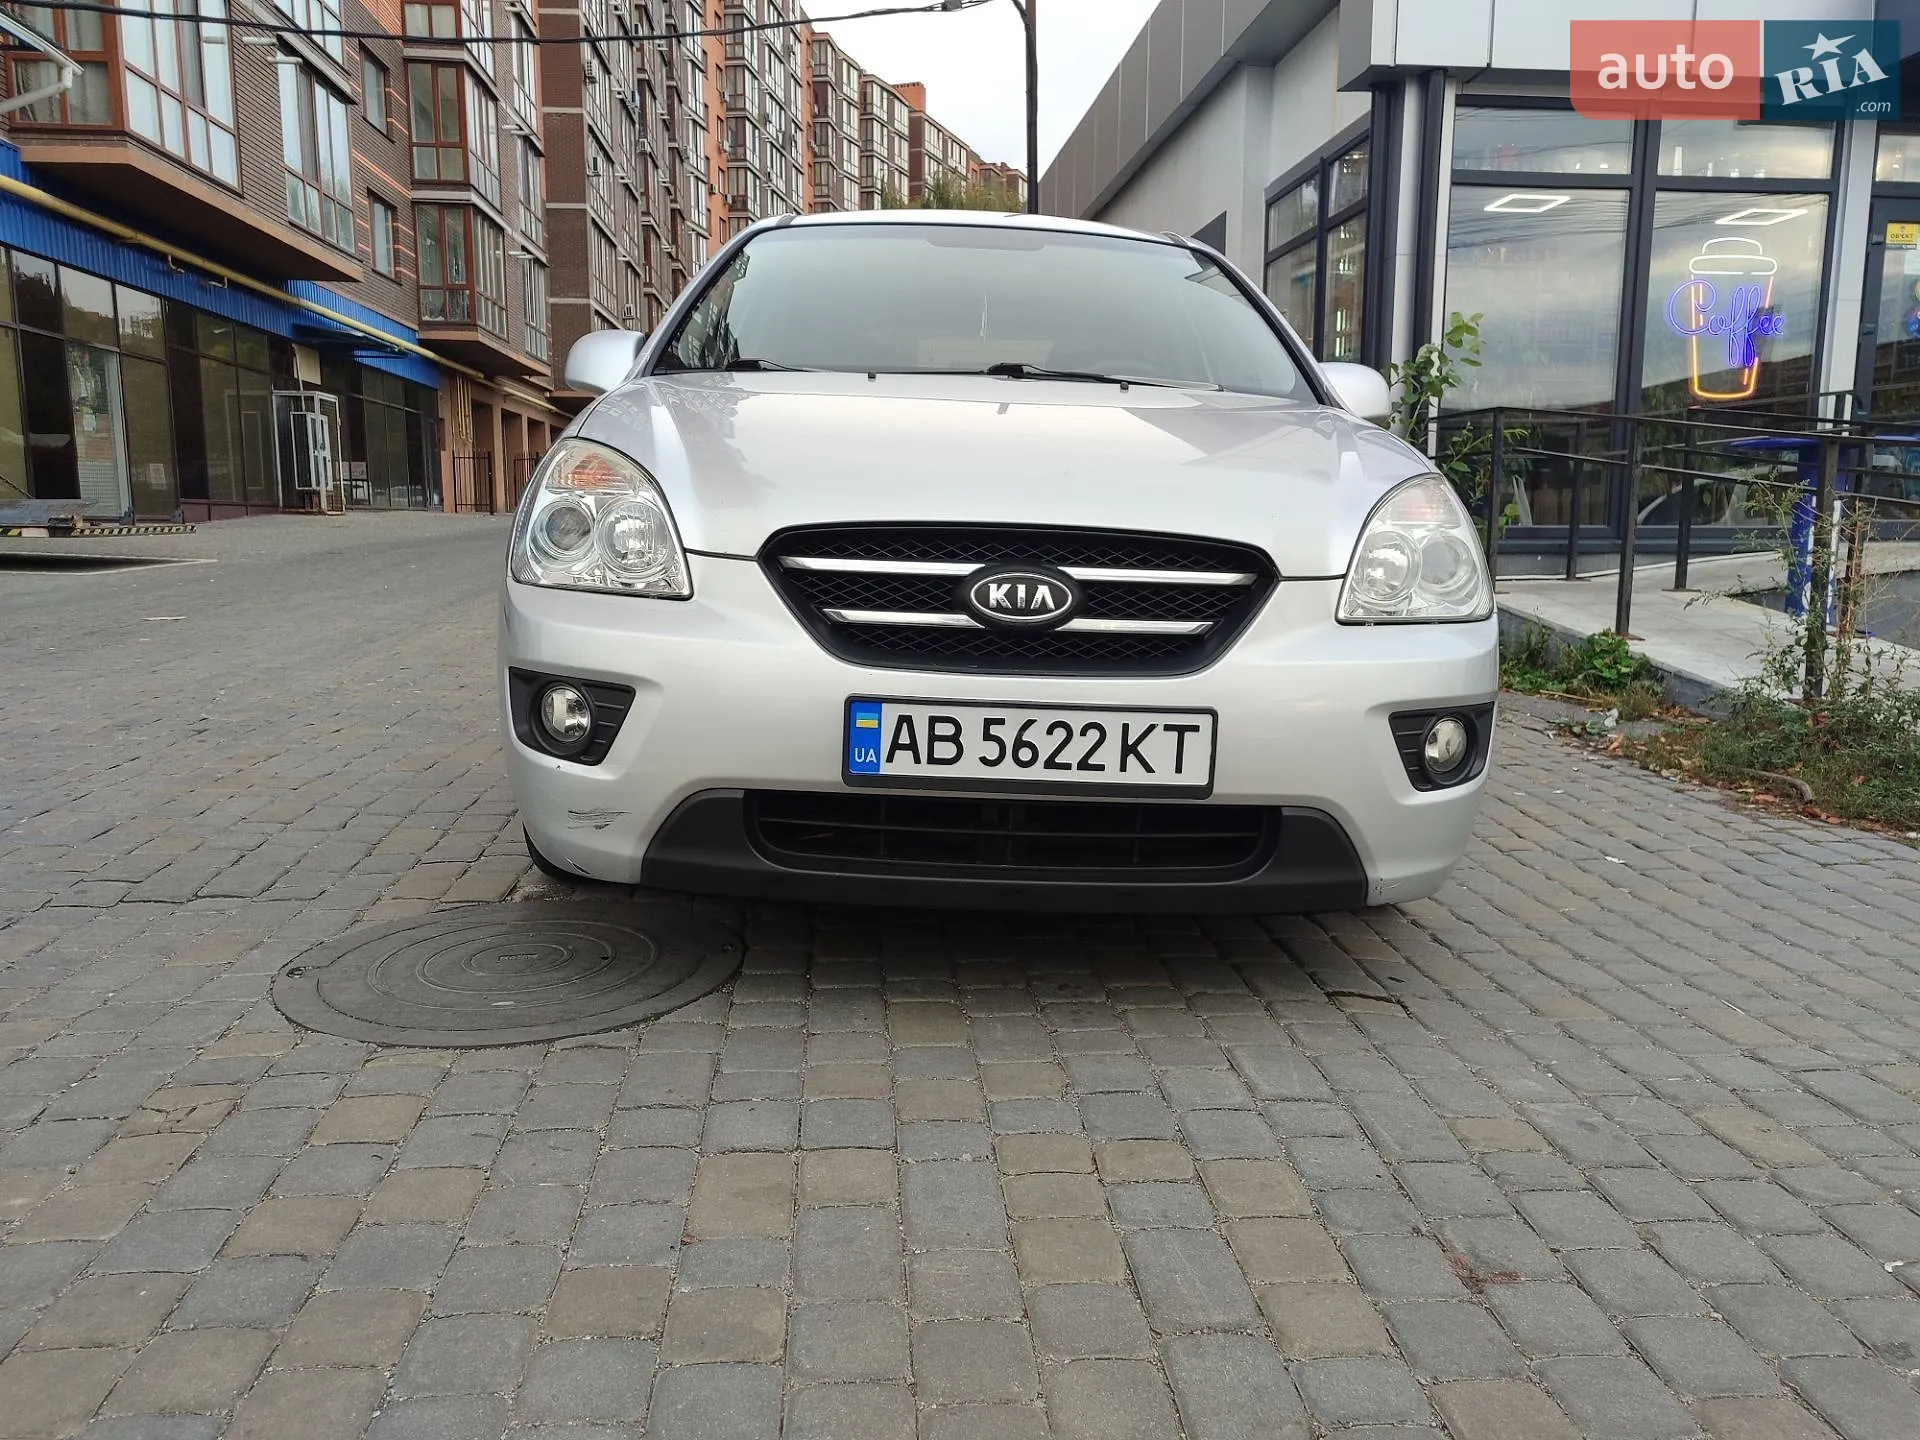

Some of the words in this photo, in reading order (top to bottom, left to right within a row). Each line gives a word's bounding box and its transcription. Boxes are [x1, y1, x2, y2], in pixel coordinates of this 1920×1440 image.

[1670, 279, 1785, 367] Coffee
[989, 584, 1056, 610] KIA
[854, 748, 877, 764] UA
[885, 714, 965, 766] AB
[978, 717, 1108, 772] 5622
[1119, 722, 1201, 774] KT
